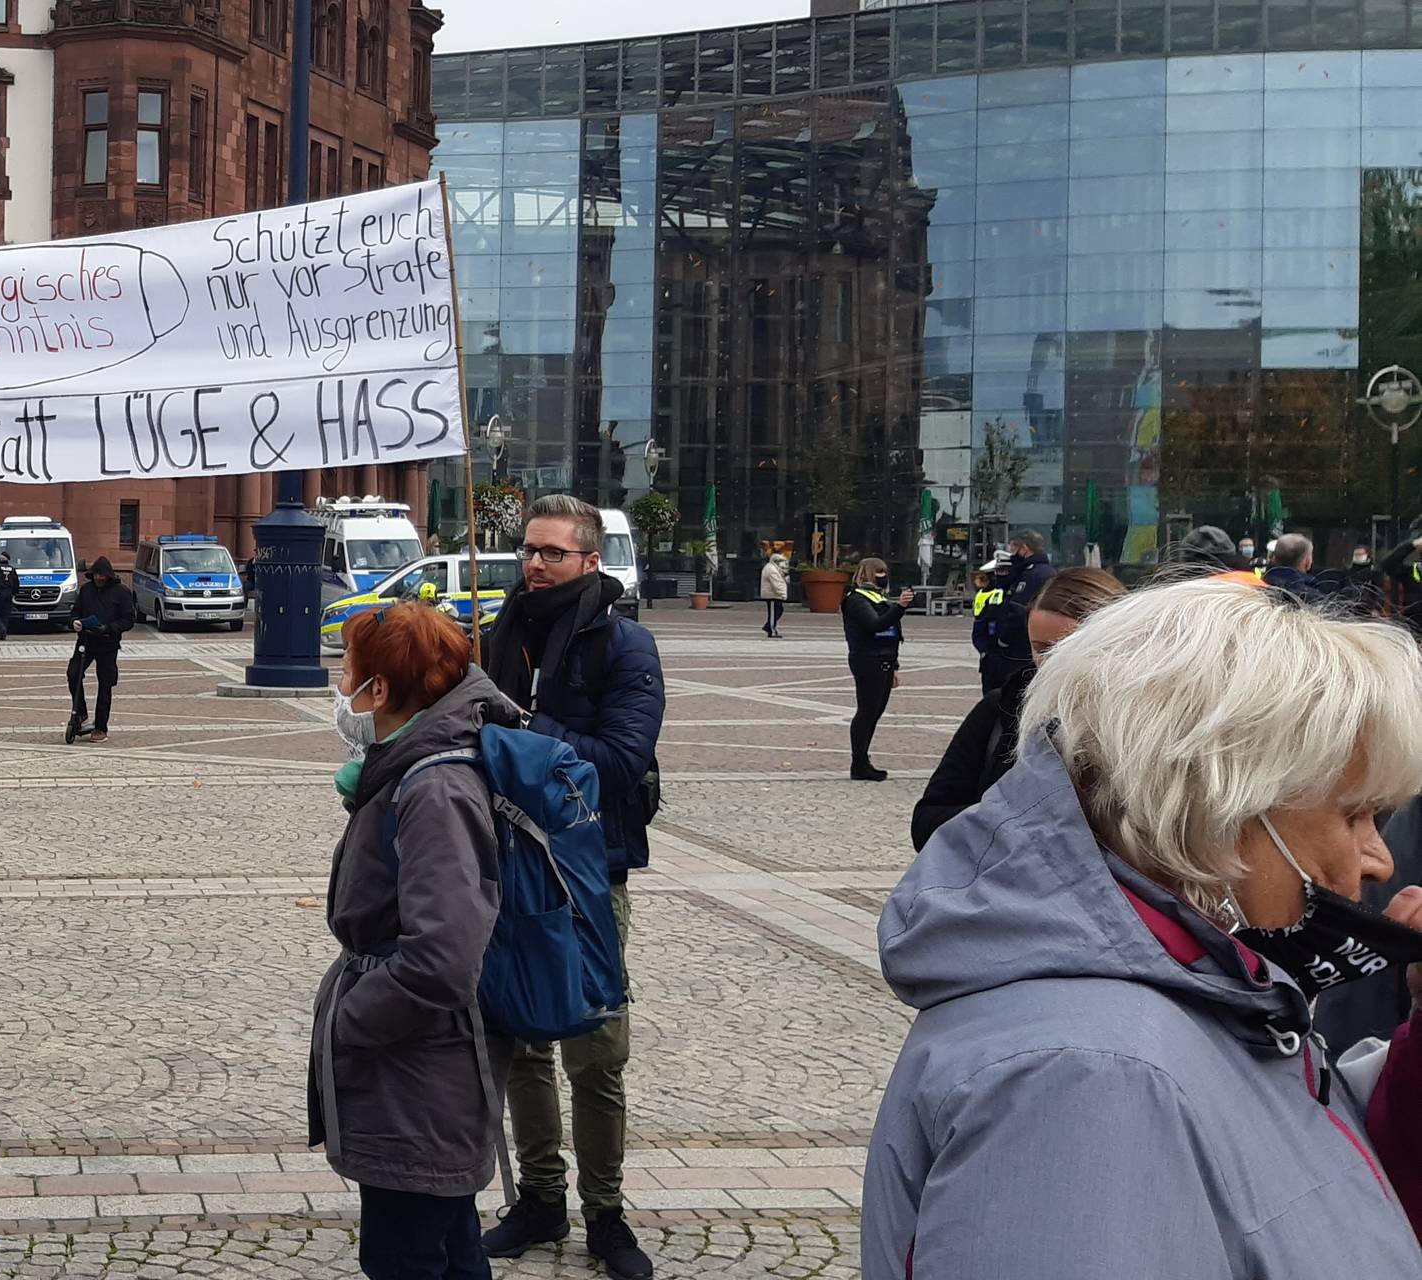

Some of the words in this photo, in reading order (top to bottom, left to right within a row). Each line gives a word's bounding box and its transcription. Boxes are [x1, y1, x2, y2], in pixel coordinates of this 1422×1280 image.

[212, 200, 349, 271] Schützt
[361, 188, 438, 248] euch
[206, 268, 260, 311] nur
[272, 263, 331, 299] vor
[342, 236, 448, 296] Strafe
[216, 300, 273, 360] und
[287, 301, 453, 371] Ausgrenzung
[94, 386, 228, 476] LÜGE
[249, 391, 296, 470] &
[317, 378, 450, 465] HASS
[1333, 936, 1389, 977] NUR
